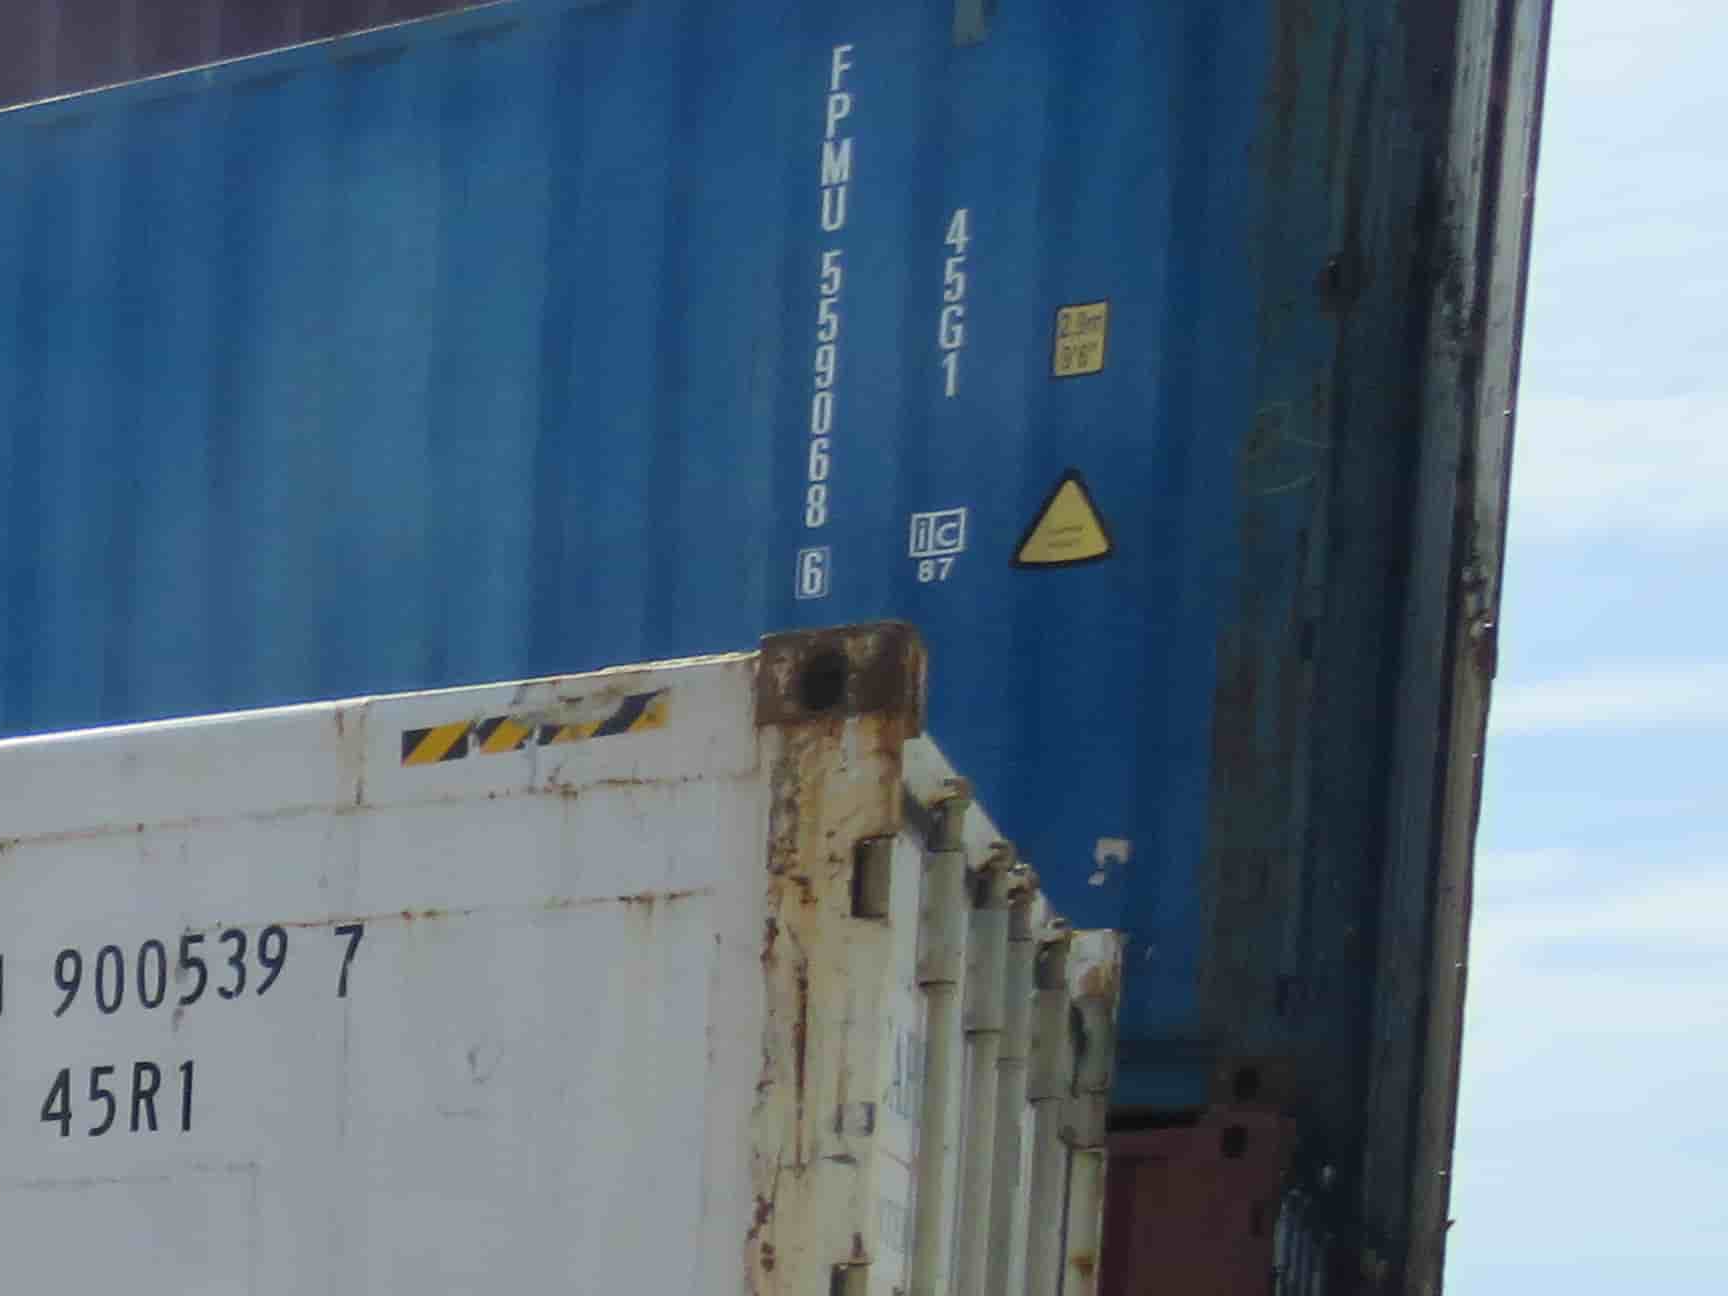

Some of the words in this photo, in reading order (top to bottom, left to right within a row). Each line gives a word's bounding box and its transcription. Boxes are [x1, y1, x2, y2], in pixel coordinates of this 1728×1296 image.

[820, 44, 854, 232] FPMU
[939, 208, 971, 399] 45G1
[805, 249, 842, 529] 559068
[800, 551, 826, 597] 6
[917, 558, 954, 583] 87
[52, 924, 289, 1018] 900539
[332, 923, 365, 999] 7
[39, 1058, 197, 1139] 45R1
